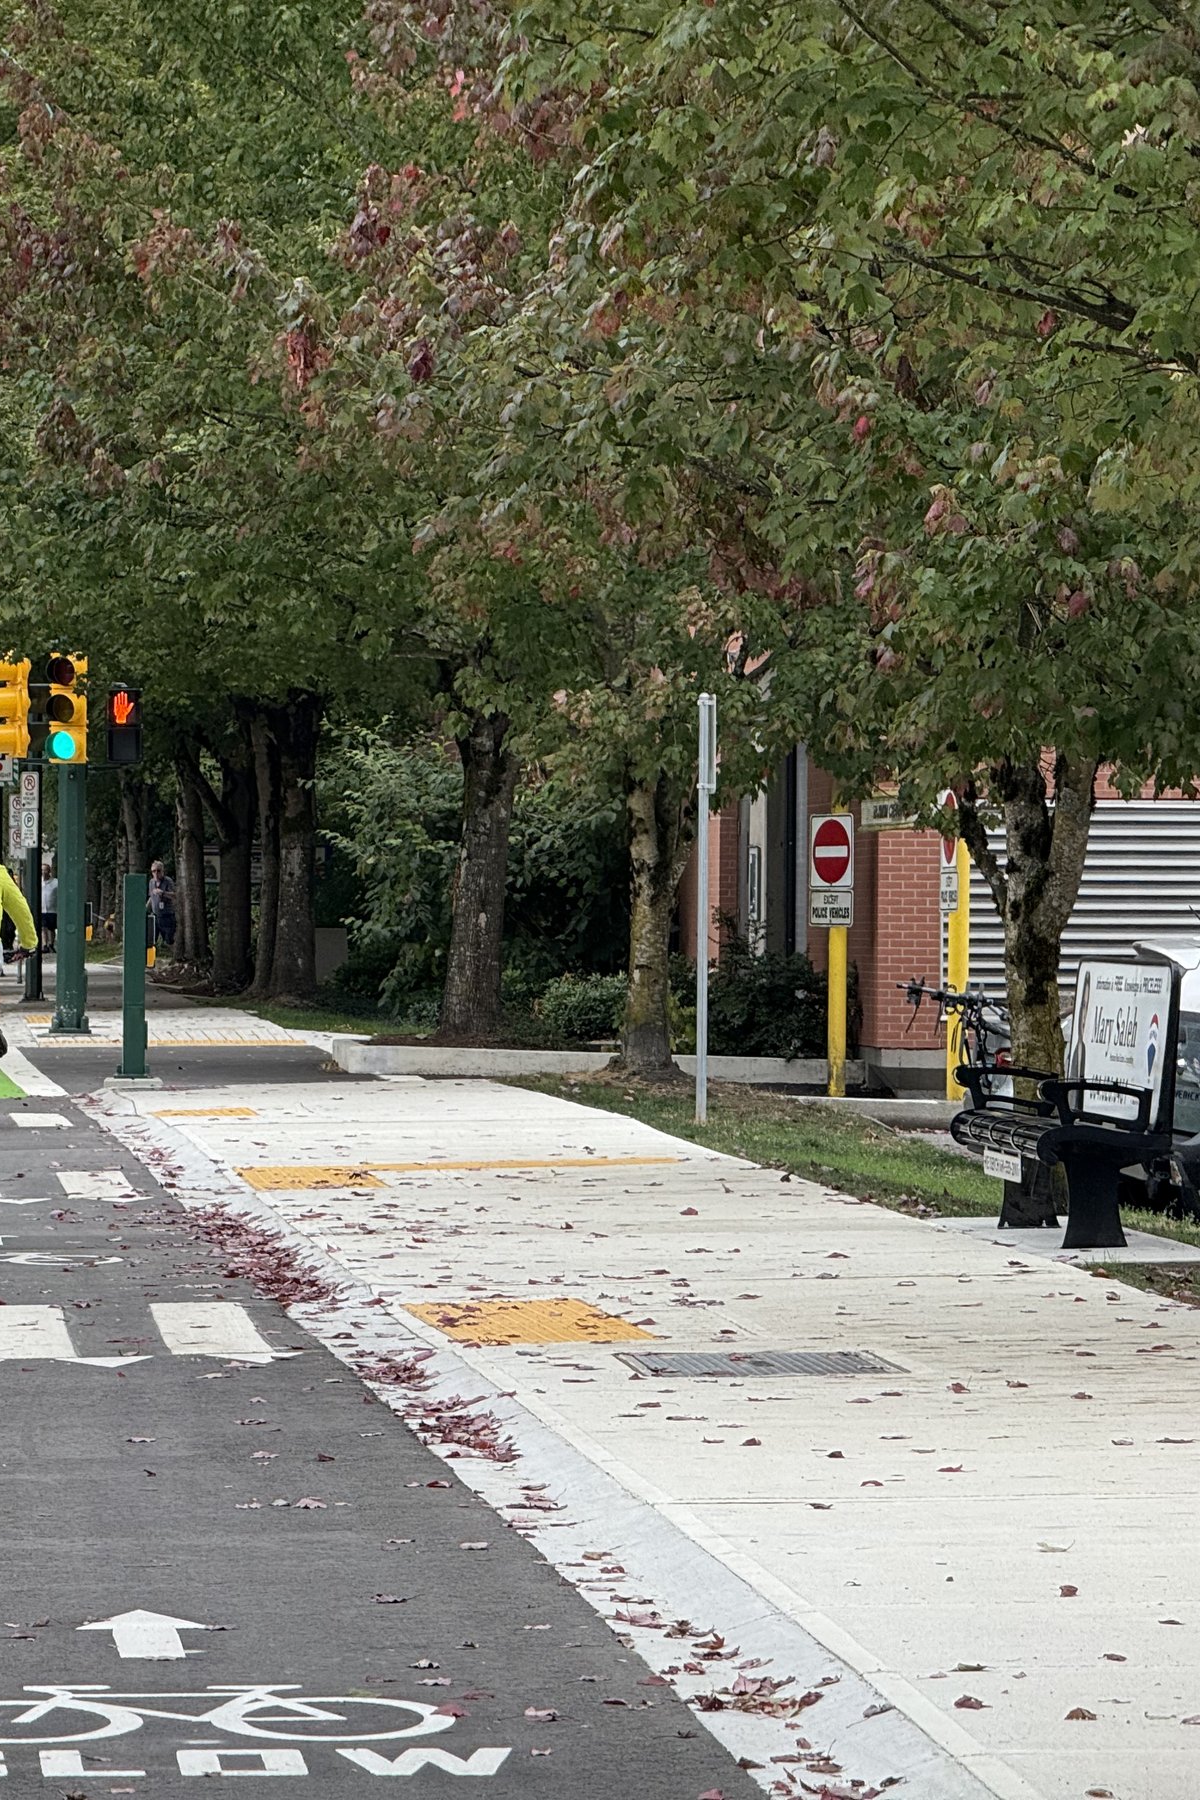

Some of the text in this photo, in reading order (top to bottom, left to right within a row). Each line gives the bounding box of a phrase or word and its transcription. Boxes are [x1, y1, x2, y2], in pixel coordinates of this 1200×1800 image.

[812, 907, 850, 919] POLICE VEHICLES
[1091, 1006, 1138, 1057] Mary Saleh
